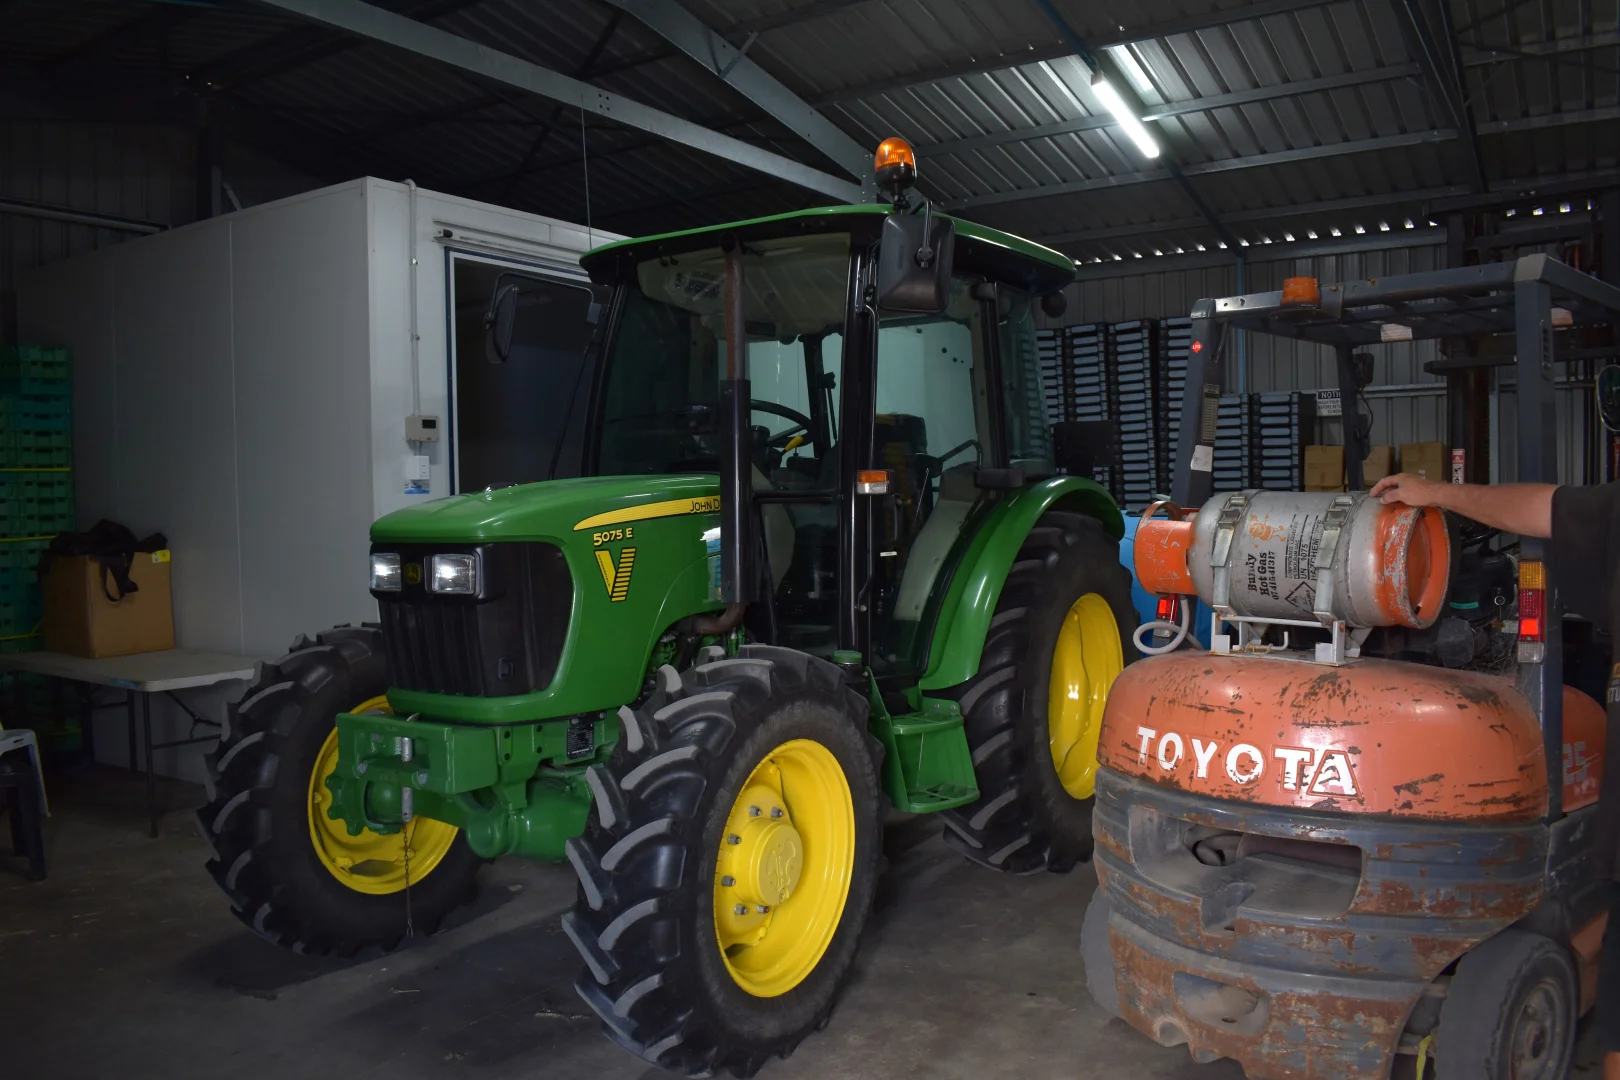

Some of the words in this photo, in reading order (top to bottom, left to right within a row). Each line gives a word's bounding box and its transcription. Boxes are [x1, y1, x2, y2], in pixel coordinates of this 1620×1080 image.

[690, 500, 713, 512] JOHN
[593, 529, 623, 546] 5075
[626, 527, 633, 538] E
[1300, 543, 1308, 562] 1075
[1257, 552, 1267, 575] Gas
[1300, 568, 1307, 579] UN
[1259, 576, 1270, 596] Hot
[1137, 725, 1359, 796] TOYOTA
